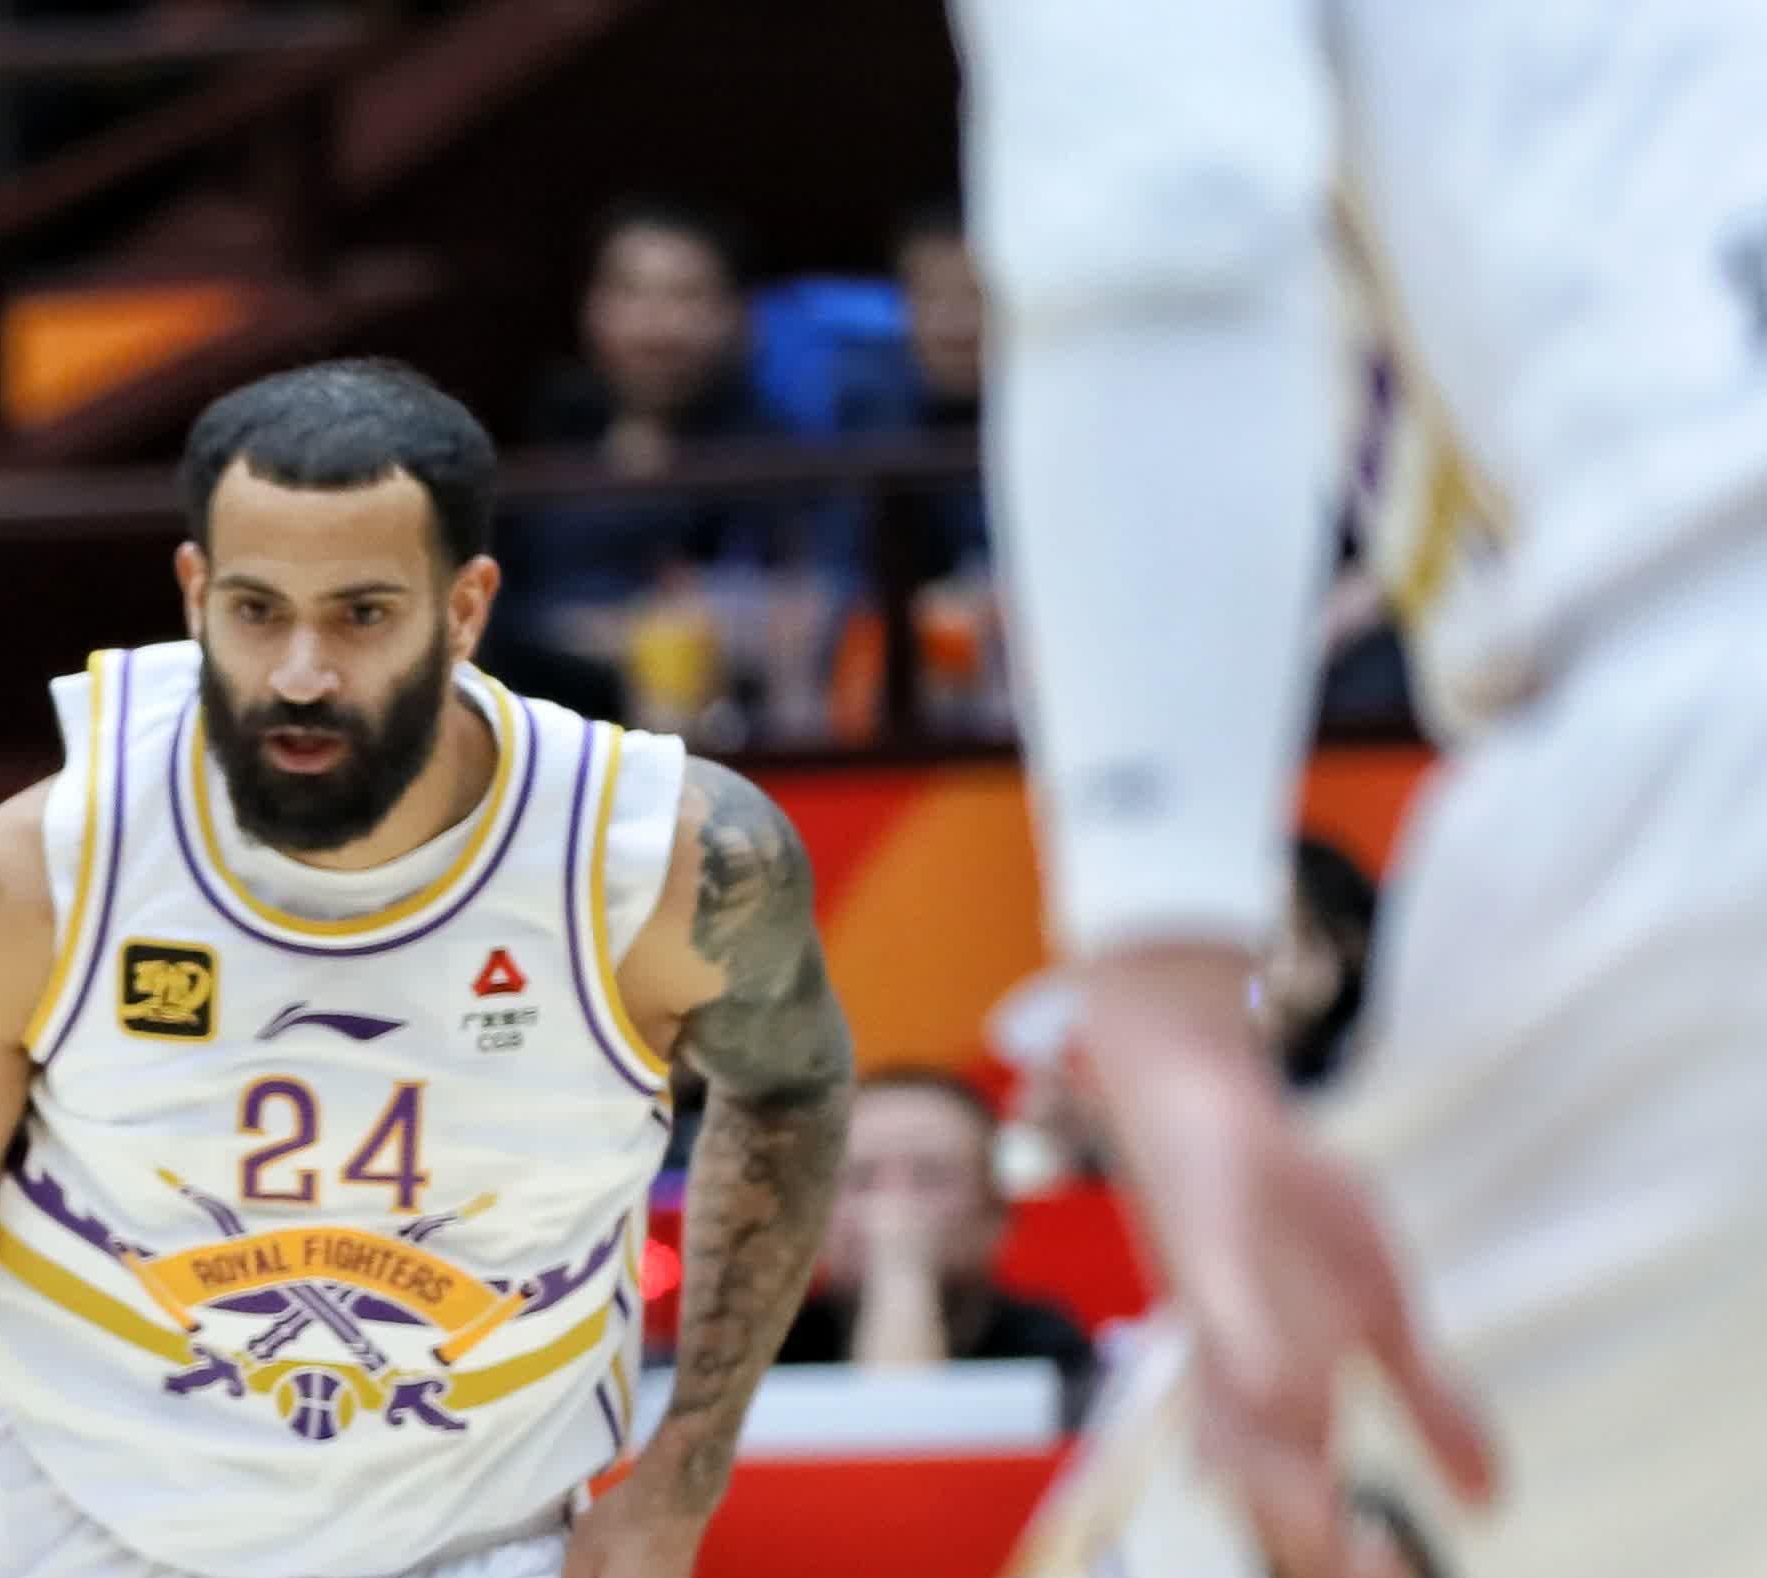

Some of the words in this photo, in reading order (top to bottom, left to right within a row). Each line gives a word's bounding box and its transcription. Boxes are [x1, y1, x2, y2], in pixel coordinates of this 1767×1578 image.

[237, 1074, 430, 1213] 24
[191, 1238, 290, 1286] ROYAL
[303, 1234, 455, 1305] FIGHTERS
